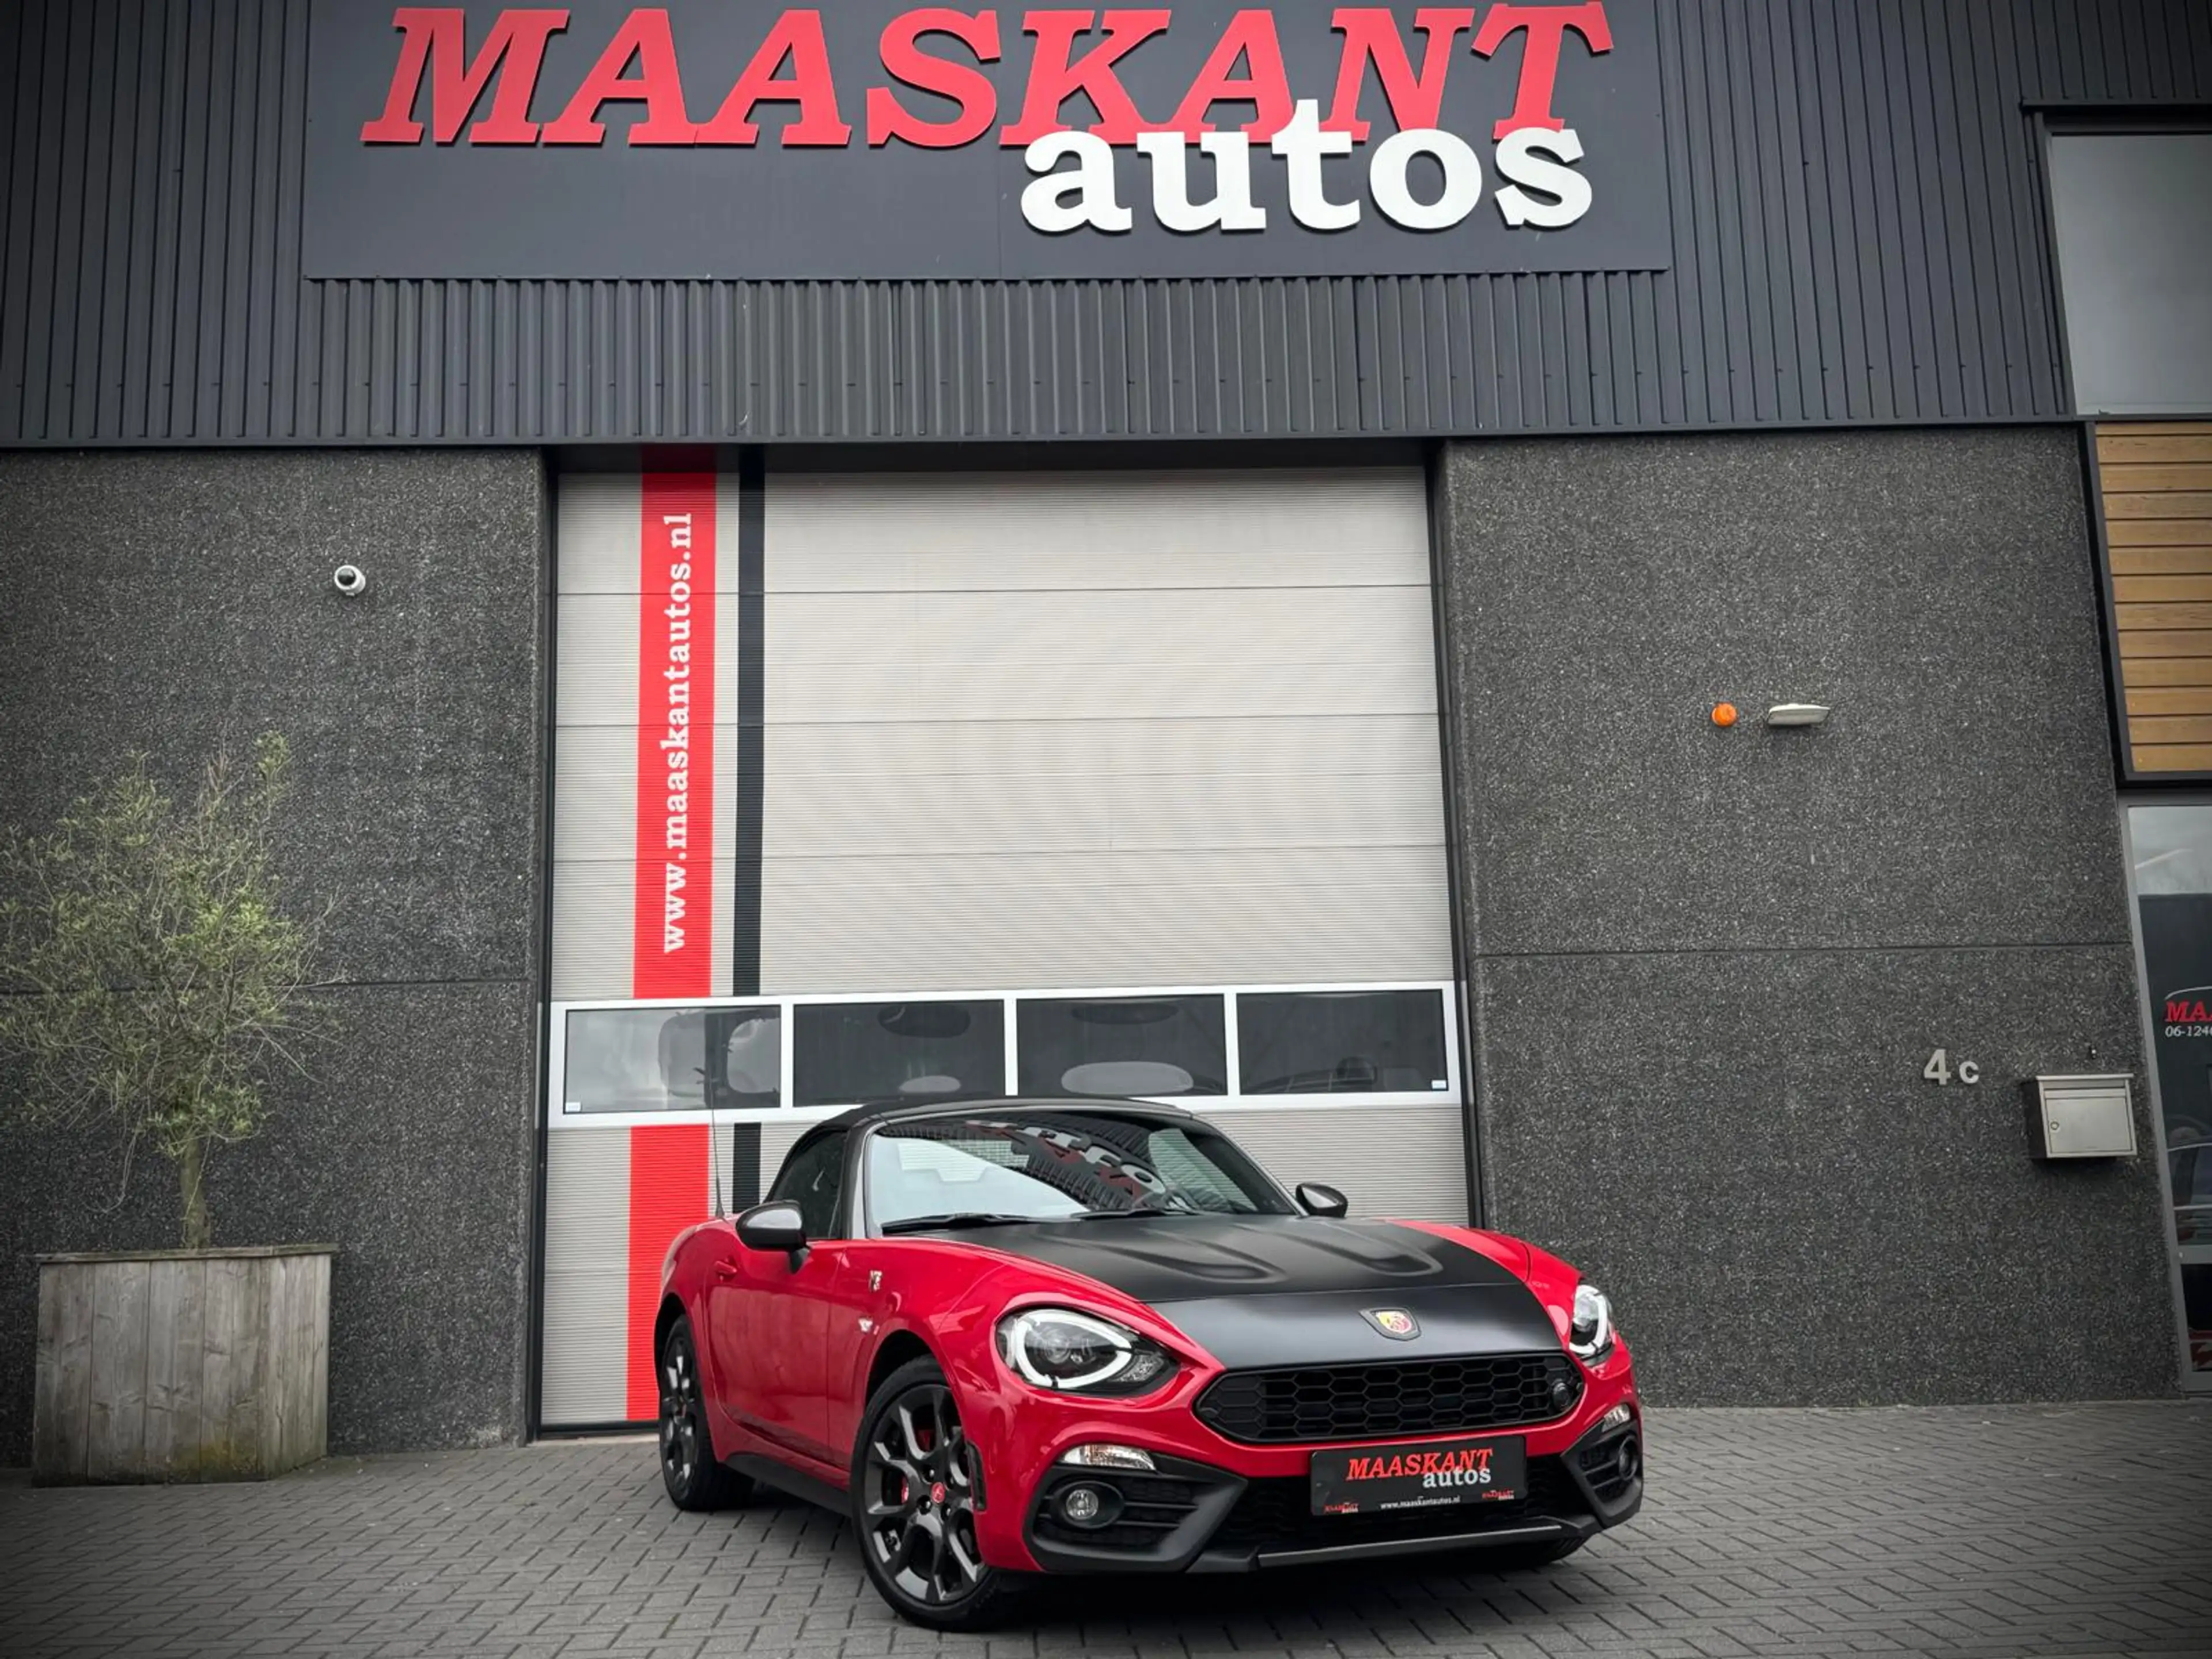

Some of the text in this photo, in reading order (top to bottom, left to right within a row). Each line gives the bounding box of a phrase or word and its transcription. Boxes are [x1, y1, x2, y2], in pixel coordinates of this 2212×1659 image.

[361, 1, 1612, 147] MAASKANT
[1021, 99, 1593, 233] autos
[660, 513, 691, 953] www.maaskantautos.nl
[2164, 1000, 2212, 1022] MA
[1346, 1448, 1493, 1481] MAASKANT
[1422, 1465, 1491, 1488] autos
